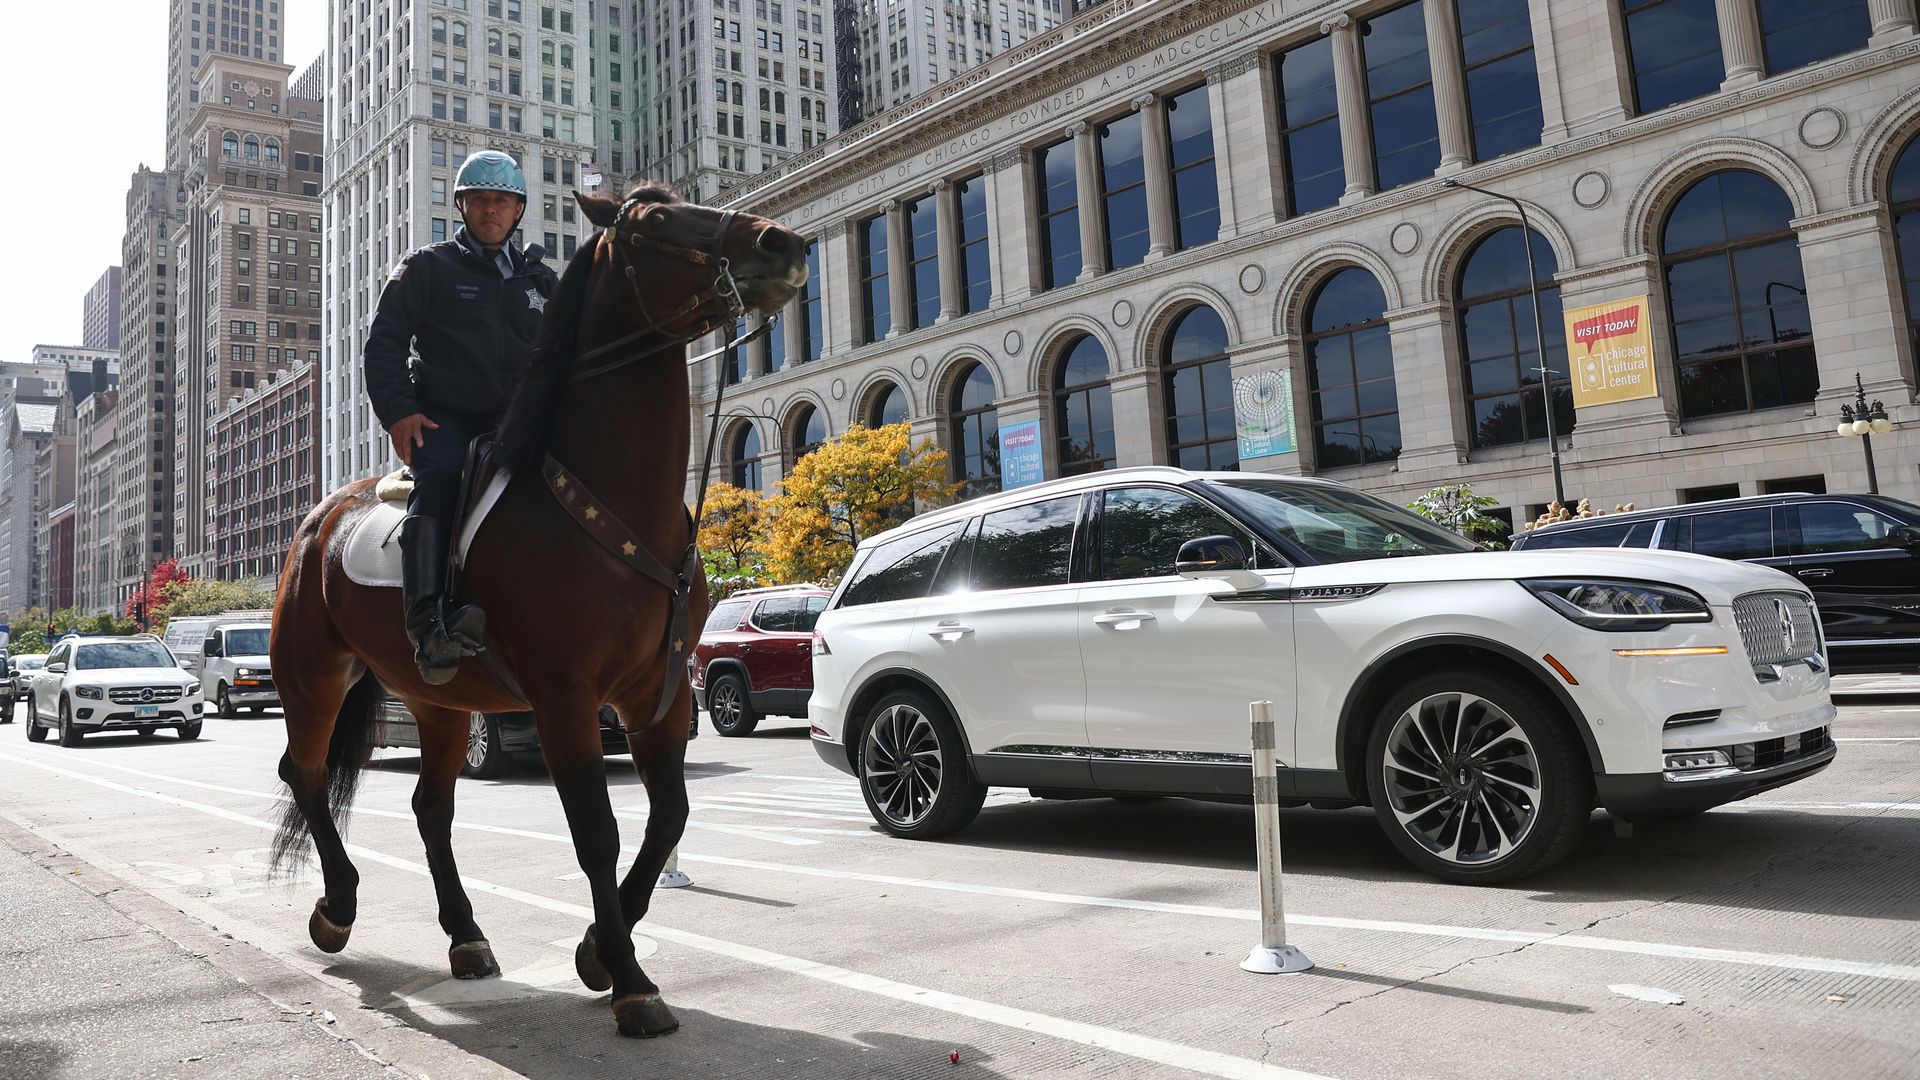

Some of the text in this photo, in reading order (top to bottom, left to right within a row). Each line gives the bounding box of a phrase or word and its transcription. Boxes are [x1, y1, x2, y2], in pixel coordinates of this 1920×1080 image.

[802, 204, 816, 218] OF
[826, 191, 849, 208] THE
[857, 174, 886, 194] CITY
[897, 161, 913, 177] OF
[925, 128, 991, 166] CHICAGO
[1010, 87, 1085, 129] FOVNDED
[1576, 318, 1637, 337] VISIT TODAY.
[1606, 346, 1646, 360] chicago
[1608, 357, 1648, 373] cultural
[1609, 374, 1641, 388] center
[1298, 587, 1364, 597] AVIATOR
